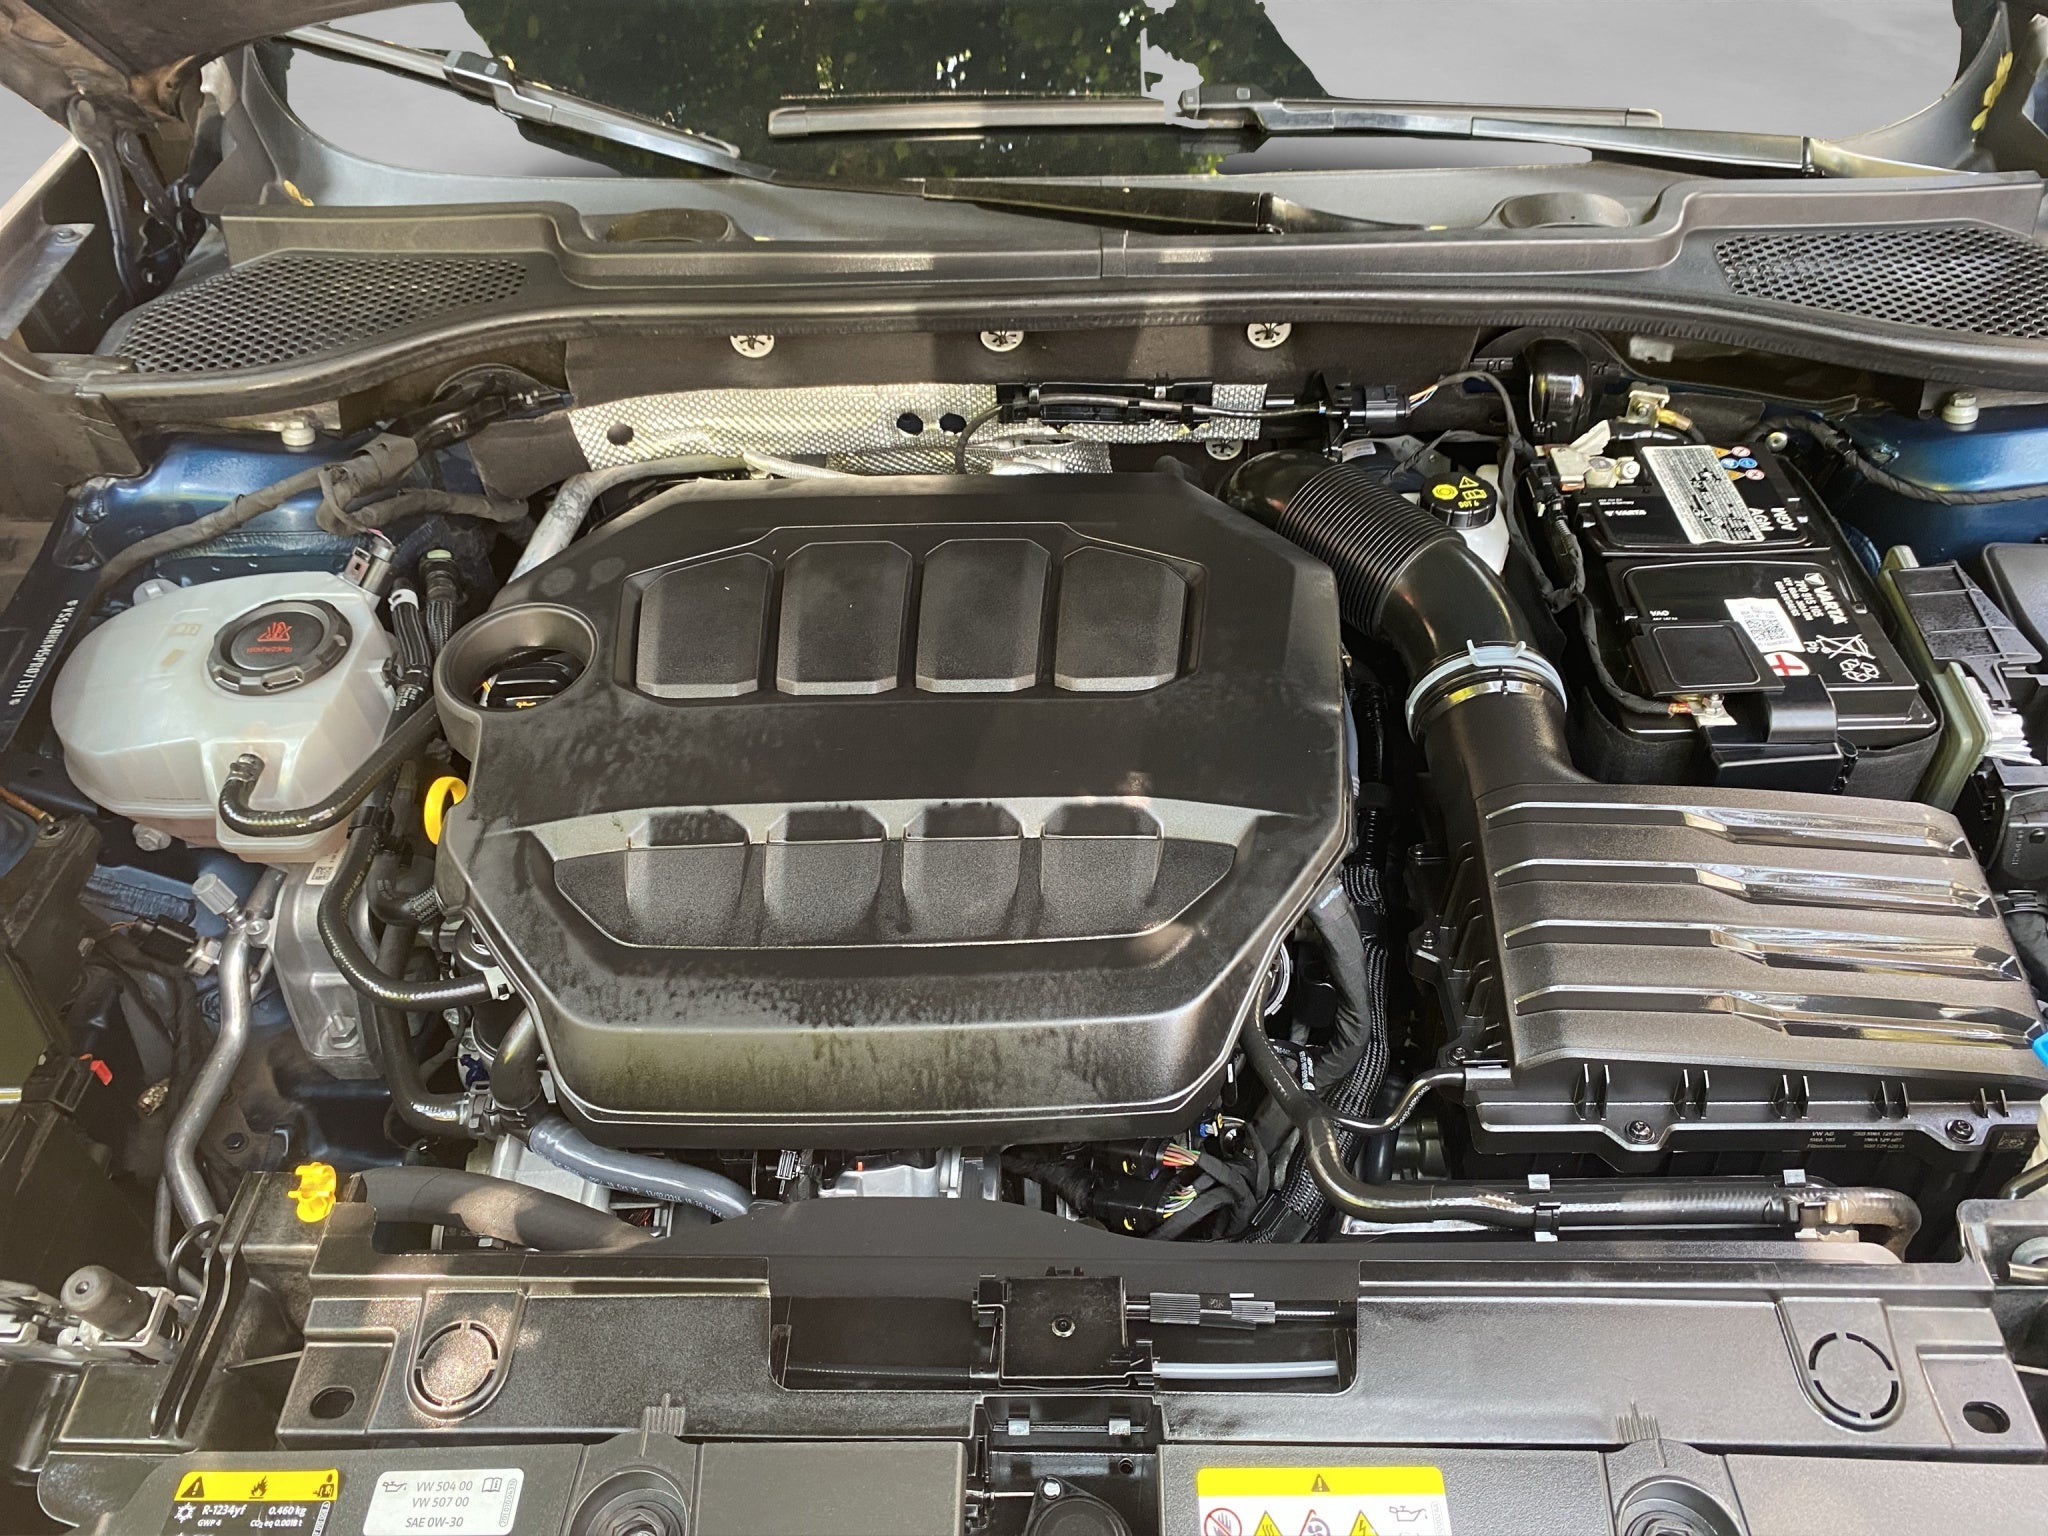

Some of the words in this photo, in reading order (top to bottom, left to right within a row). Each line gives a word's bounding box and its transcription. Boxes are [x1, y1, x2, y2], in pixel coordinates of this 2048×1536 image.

[1749, 507, 1775, 532] AGM
[1771, 507, 1798, 532] AGM
[1814, 586, 1848, 625] VARTA
[1803, 641, 1819, 654] Pb
[416, 1481, 435, 1492] VW
[435, 1481, 458, 1491] 504
[459, 1480, 473, 1491] 00
[412, 1497, 431, 1508] VW
[432, 1496, 454, 1507] 507
[455, 1496, 470, 1507] 00
[201, 1504, 248, 1518] R-1234yf
[268, 1505, 295, 1515] 0.460
[295, 1506, 308, 1518] kg
[197, 1519, 215, 1527] GWP
[215, 1519, 222, 1527] 4
[405, 1517, 426, 1528] SAE
[427, 1516, 464, 1527] 0W-30
